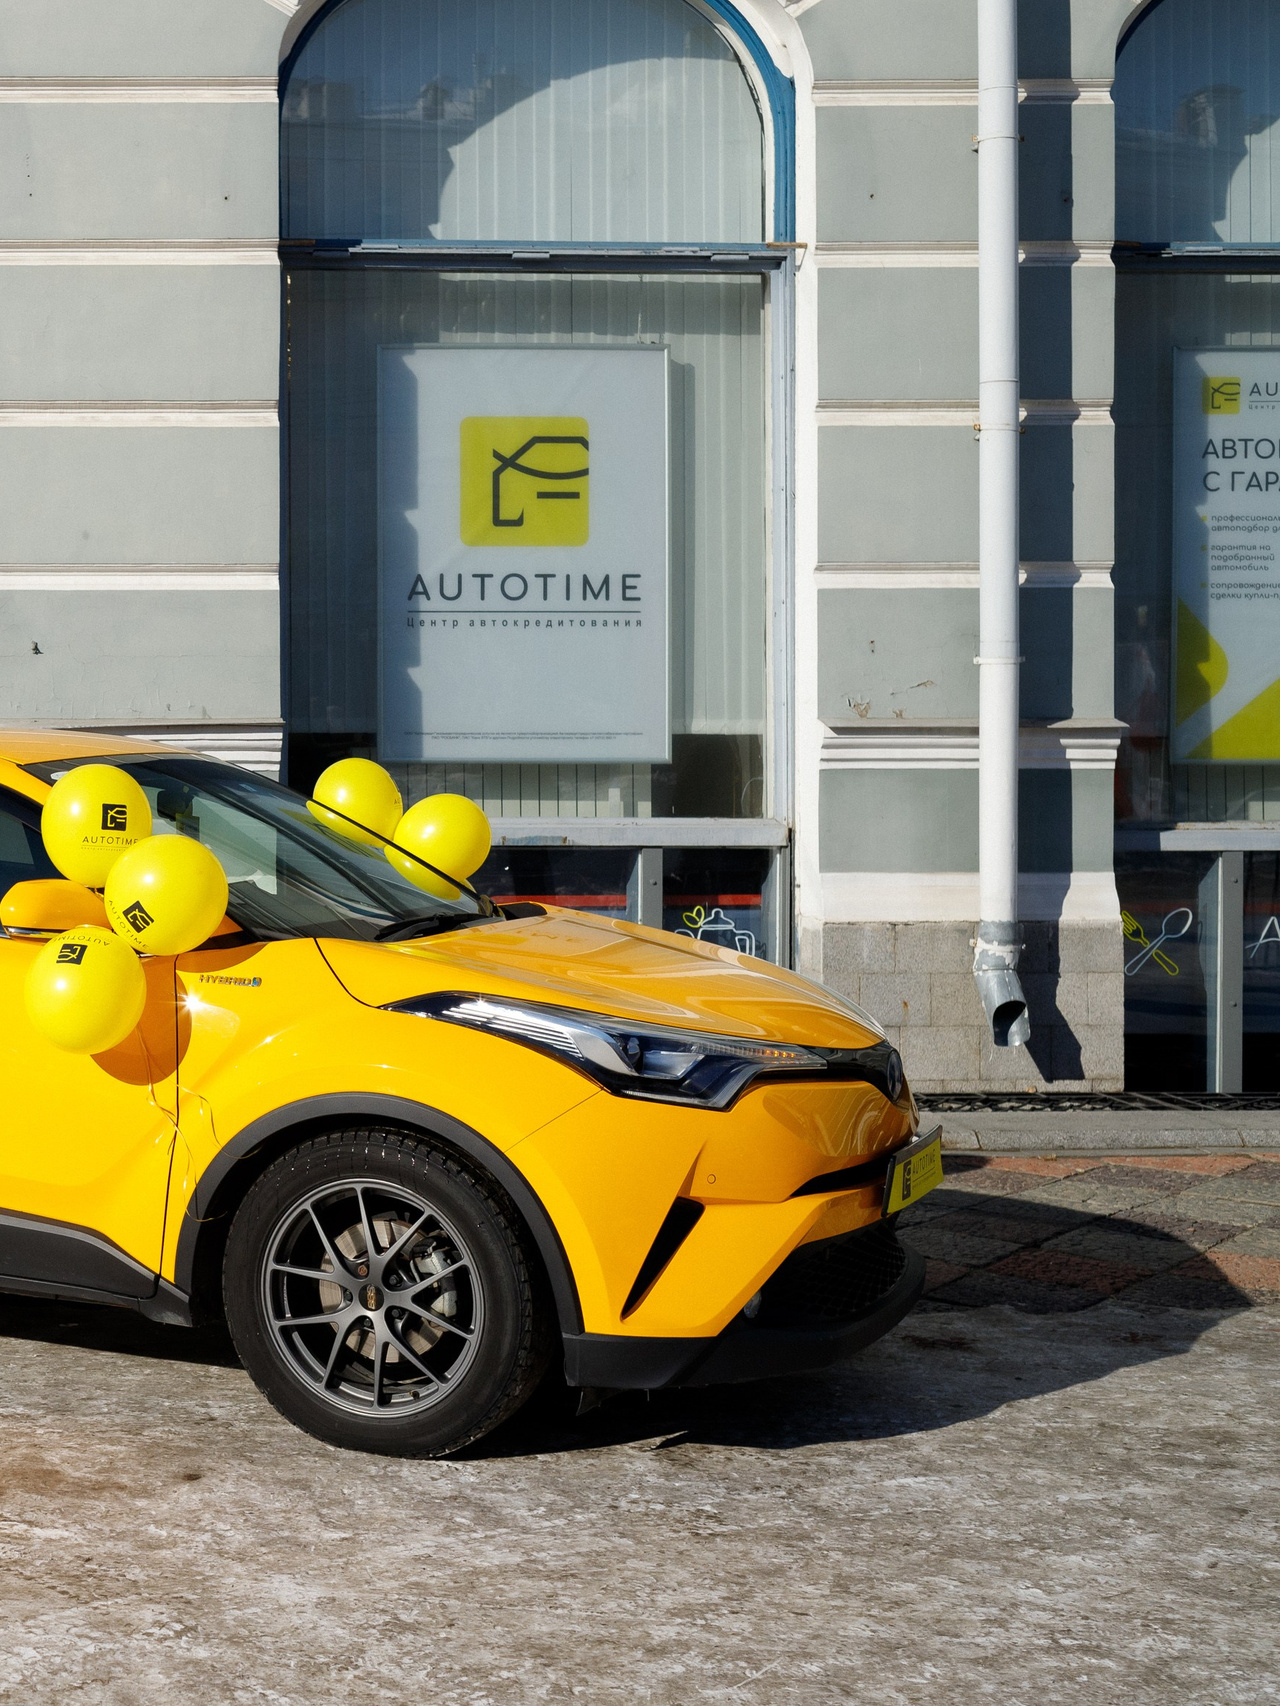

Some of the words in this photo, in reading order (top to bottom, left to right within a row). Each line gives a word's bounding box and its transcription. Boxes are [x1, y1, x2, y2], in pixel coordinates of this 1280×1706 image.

[1201, 438, 1280, 459] АВТО
[1202, 471, 1220, 492] С
[1231, 471, 1280, 492] ГАР
[1211, 524, 1270, 533] автоподбор
[1210, 545, 1257, 553] гарантия
[1210, 553, 1275, 562] подобранный
[1210, 563, 1269, 571] автомобиль
[407, 573, 642, 601] AUTOTIME
[407, 617, 459, 629] Центр
[469, 617, 642, 629] автокредитования
